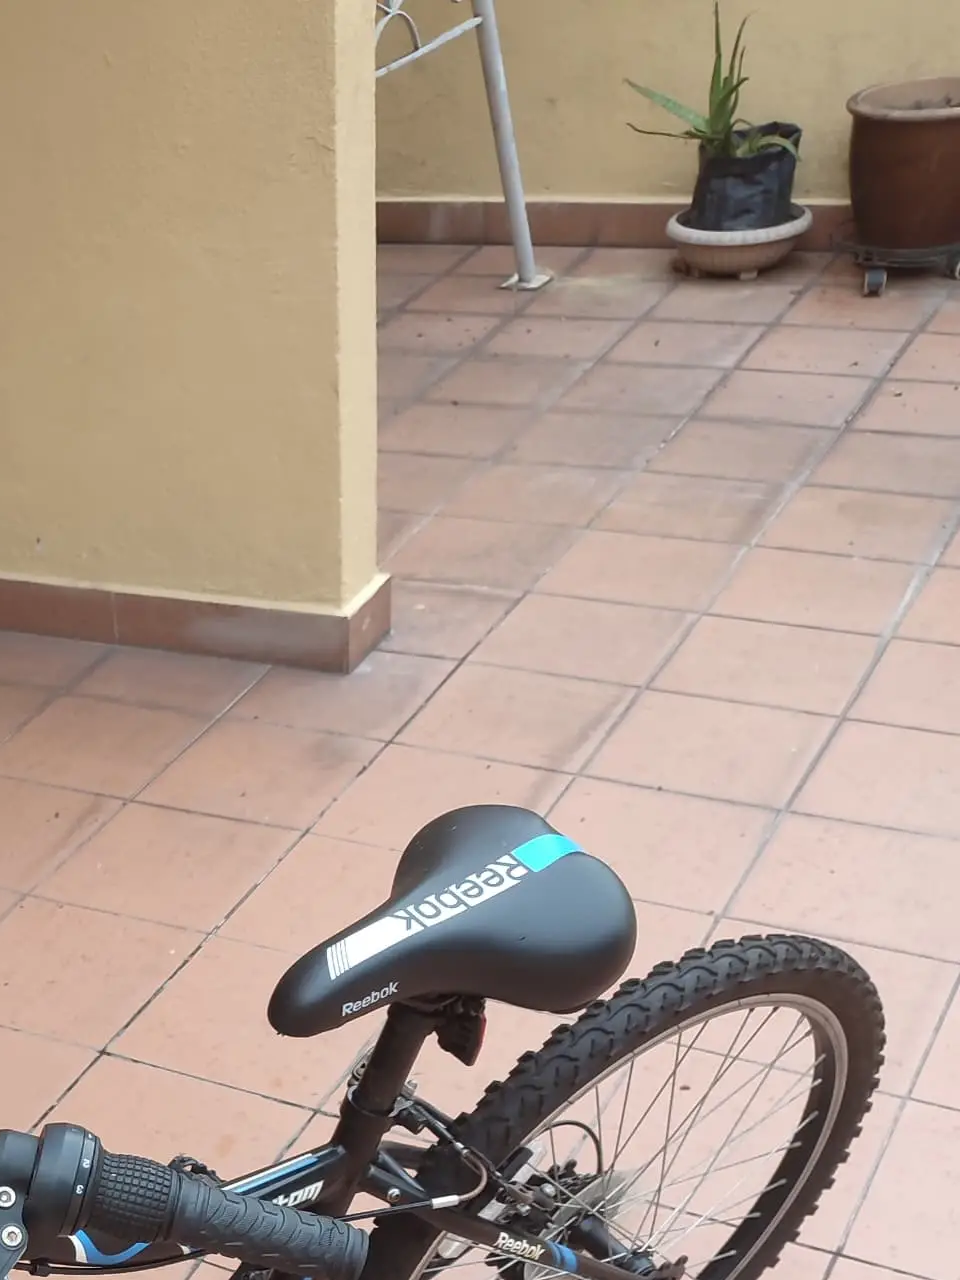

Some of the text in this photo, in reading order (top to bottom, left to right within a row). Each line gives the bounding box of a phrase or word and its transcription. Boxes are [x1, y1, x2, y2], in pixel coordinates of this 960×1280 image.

[395, 853, 528, 931] Reebok
[341, 981, 400, 1017] Reebok
[492, 1231, 546, 1261] Reebok
